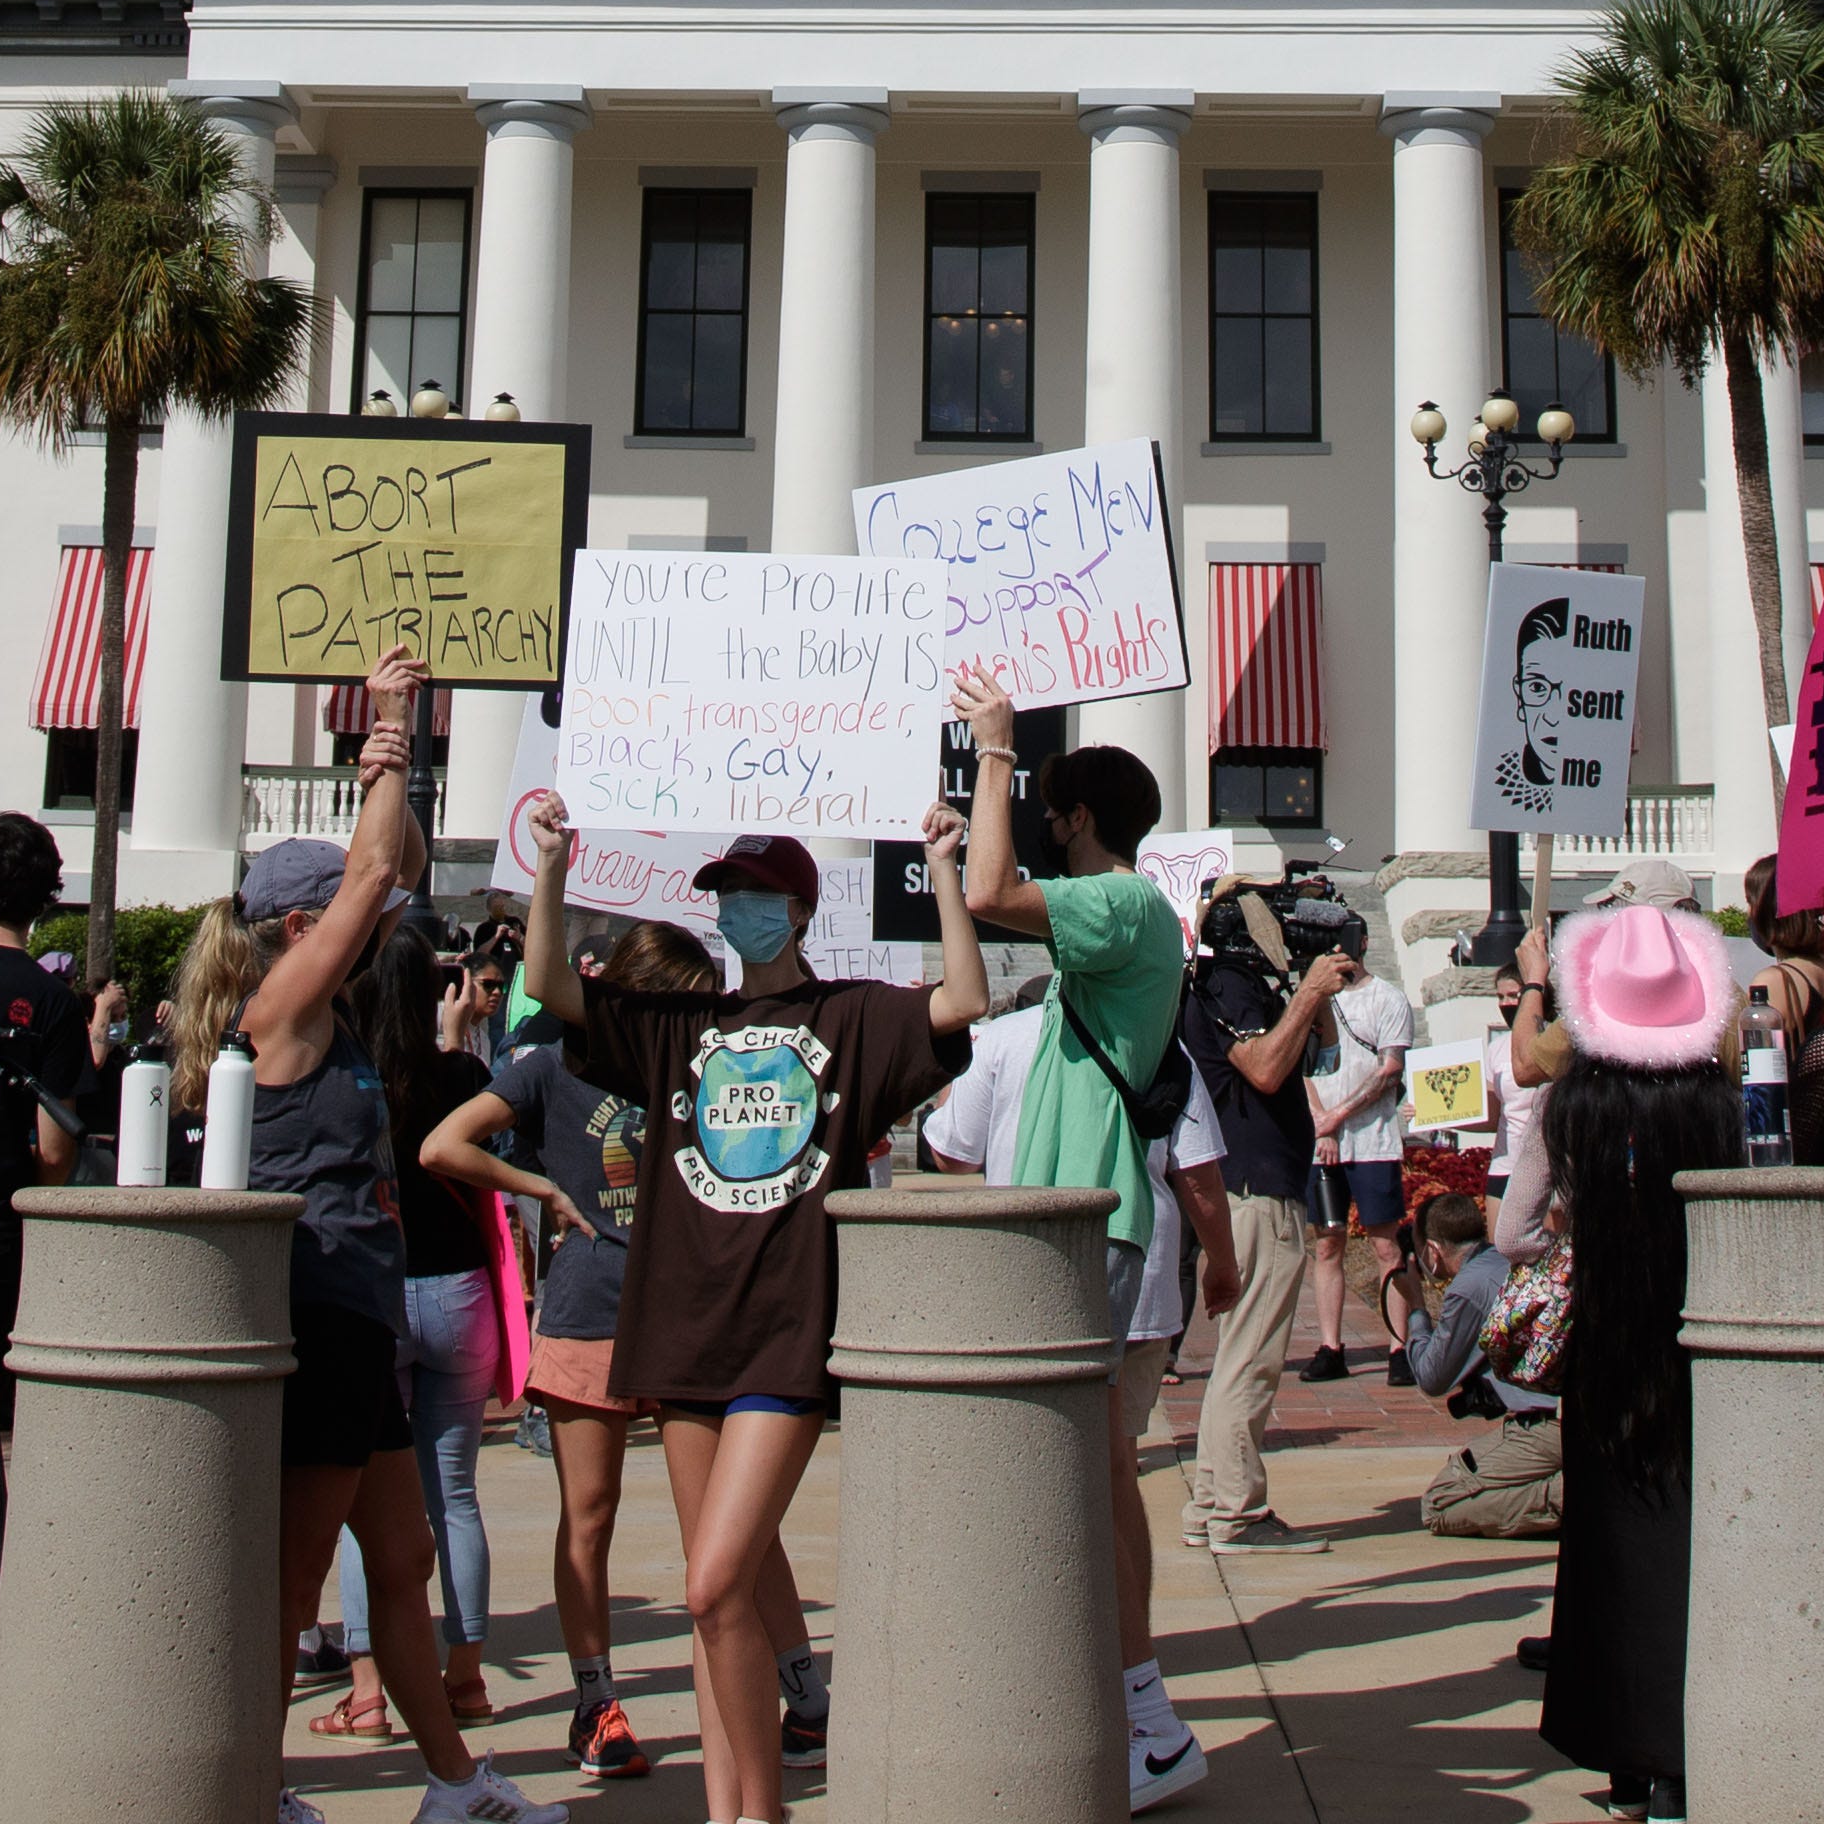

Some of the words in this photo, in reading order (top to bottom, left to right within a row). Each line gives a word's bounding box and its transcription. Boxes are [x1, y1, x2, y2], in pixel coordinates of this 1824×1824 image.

[262, 451, 492, 536] ABORT
[332, 540, 469, 603] THE
[276, 583, 555, 673] PATRIARCHY
[1573, 614, 1632, 652] Ruth
[576, 616, 690, 688] UNTIL
[718, 626, 781, 684] the
[798, 627, 883, 702] Baby
[683, 692, 913, 750] transgender,
[1567, 687, 1625, 721] sent
[1561, 757, 1601, 788] me
[808, 913, 845, 940] HE
[801, 940, 894, 980] -TEM
[744, 1029, 822, 1066] CHOICE
[709, 1105, 797, 1125] PLANET
[729, 1086, 775, 1104] PRO
[585, 1094, 620, 1139] FIGHT
[683, 1156, 717, 1197] PRO
[730, 1155, 823, 1206] SCIENCE
